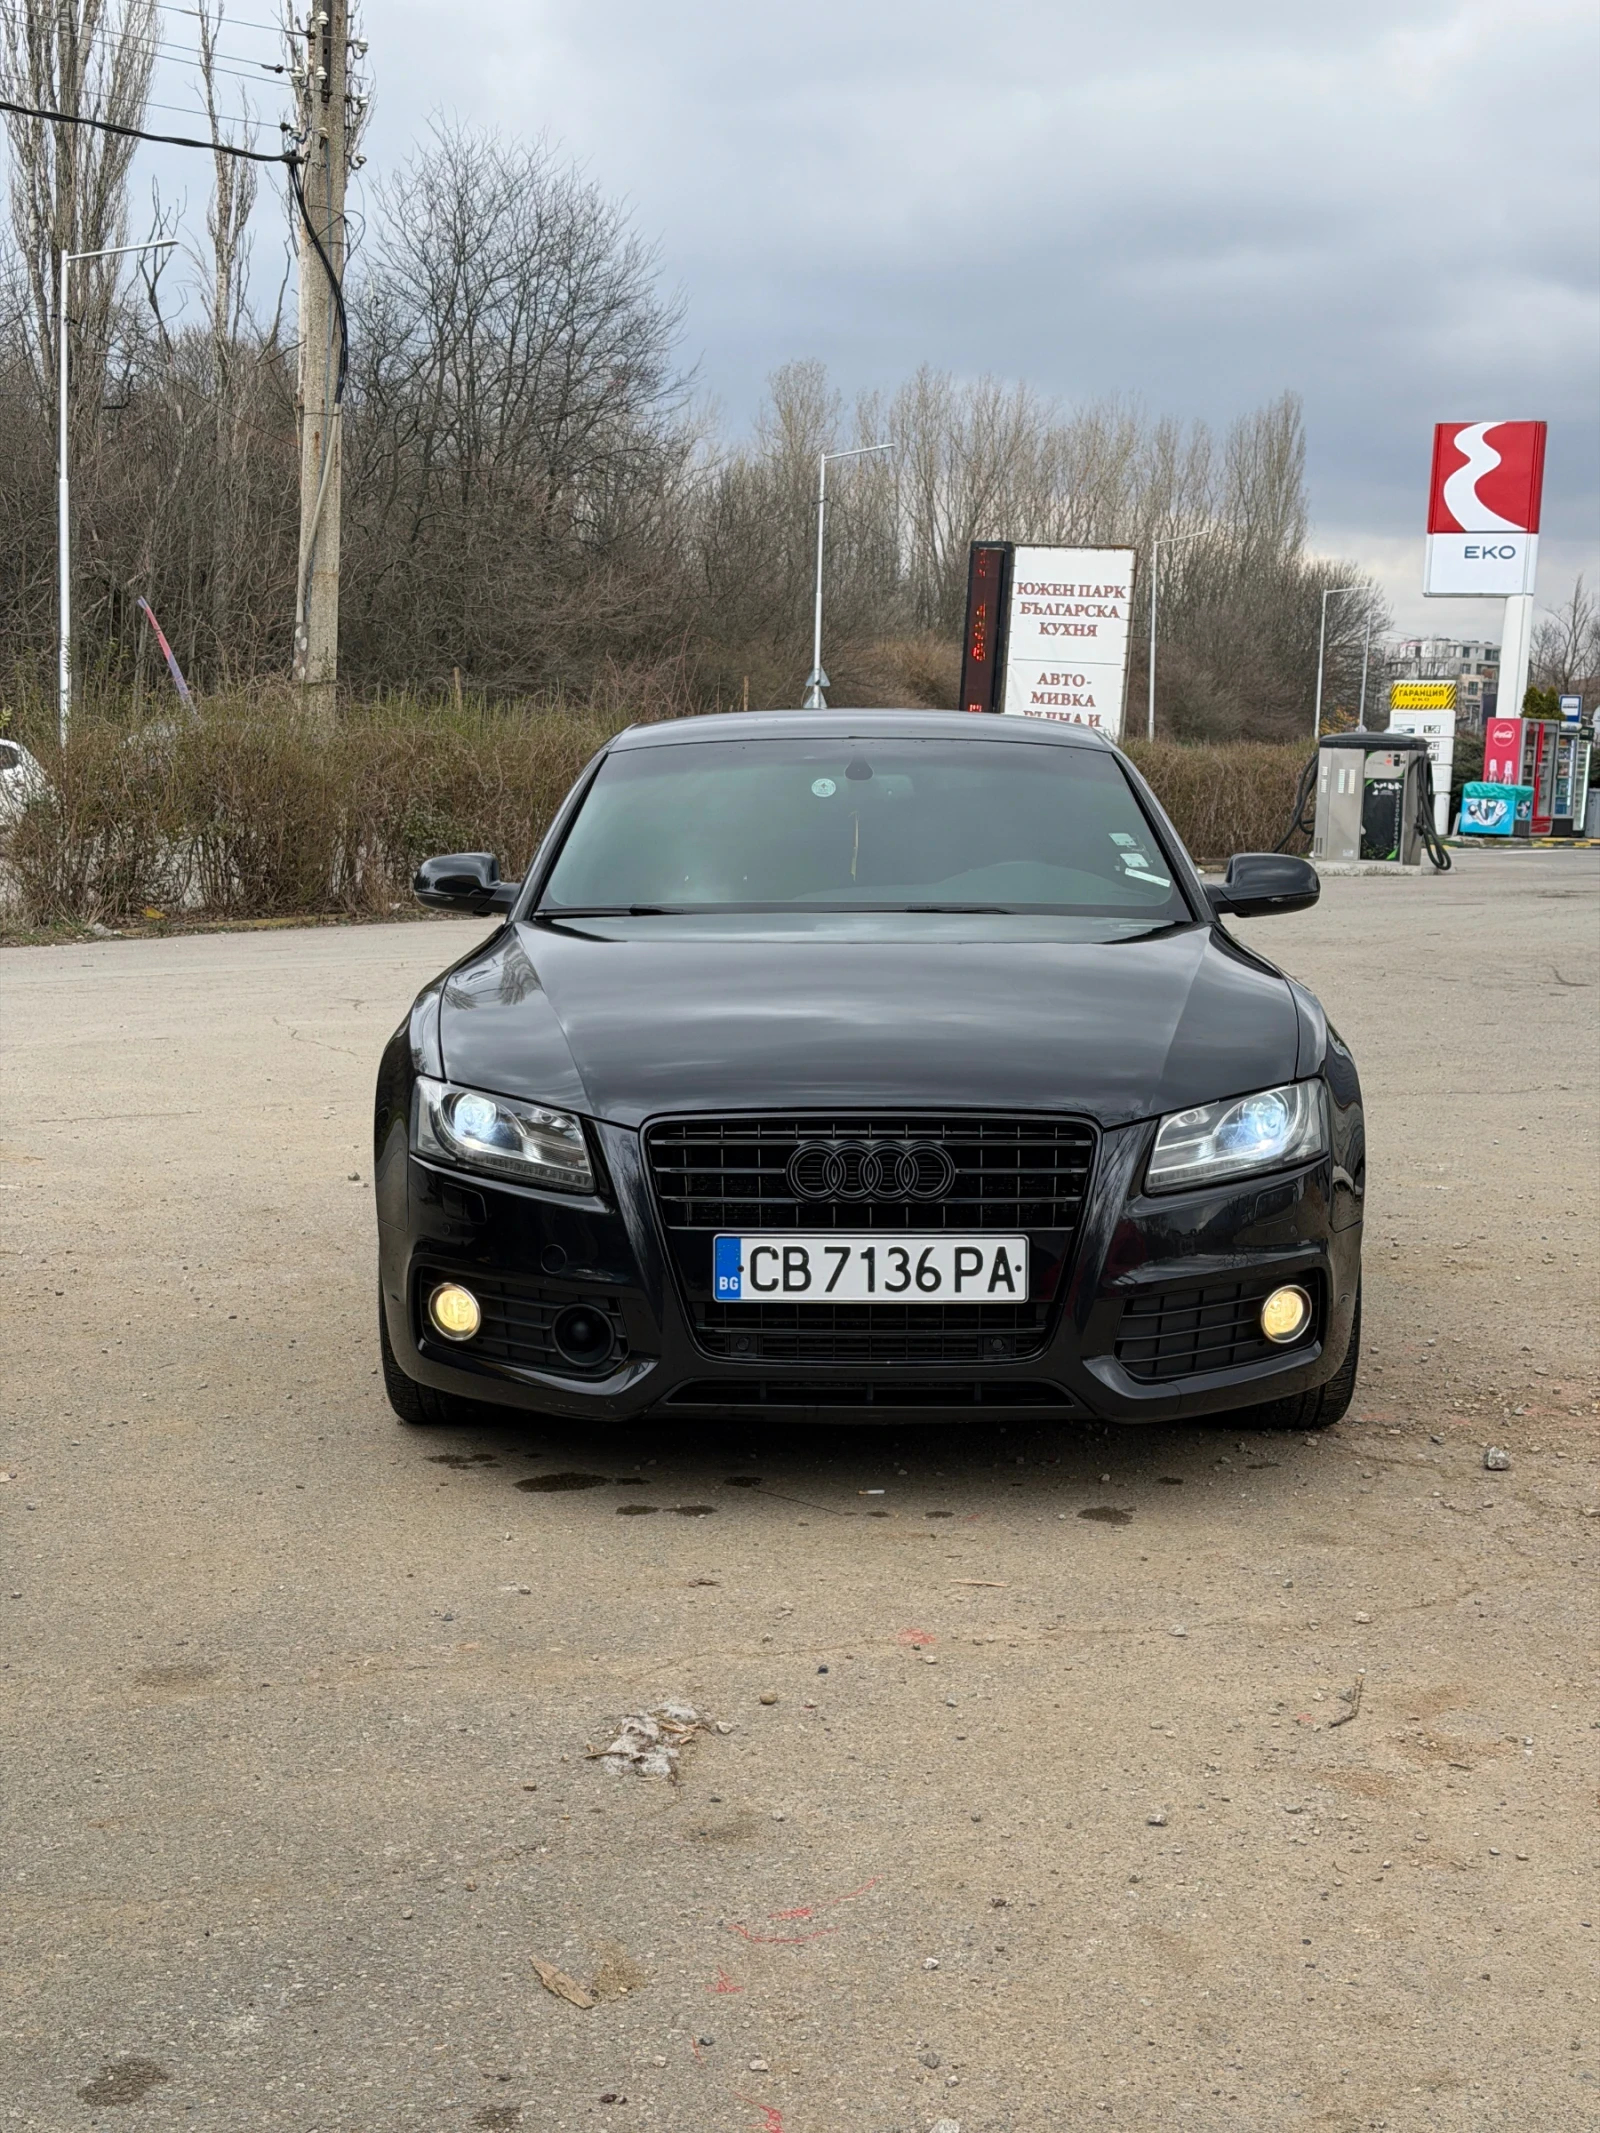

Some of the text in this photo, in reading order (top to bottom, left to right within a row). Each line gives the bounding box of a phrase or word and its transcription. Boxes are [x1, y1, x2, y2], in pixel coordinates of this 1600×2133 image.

[1464, 545, 1516, 560] EKO
[1016, 582, 1127, 599] ЮЖЕН ПАРК
[1019, 601, 1121, 619] БЪЛГАРСКА
[1038, 622, 1099, 637] КУХНЯ
[1037, 672, 1092, 687] АВТО-
[1030, 691, 1096, 708] МИВКА
[1398, 689, 1445, 698] ГАРАНЦИЯ
[719, 1276, 739, 1291] BG
